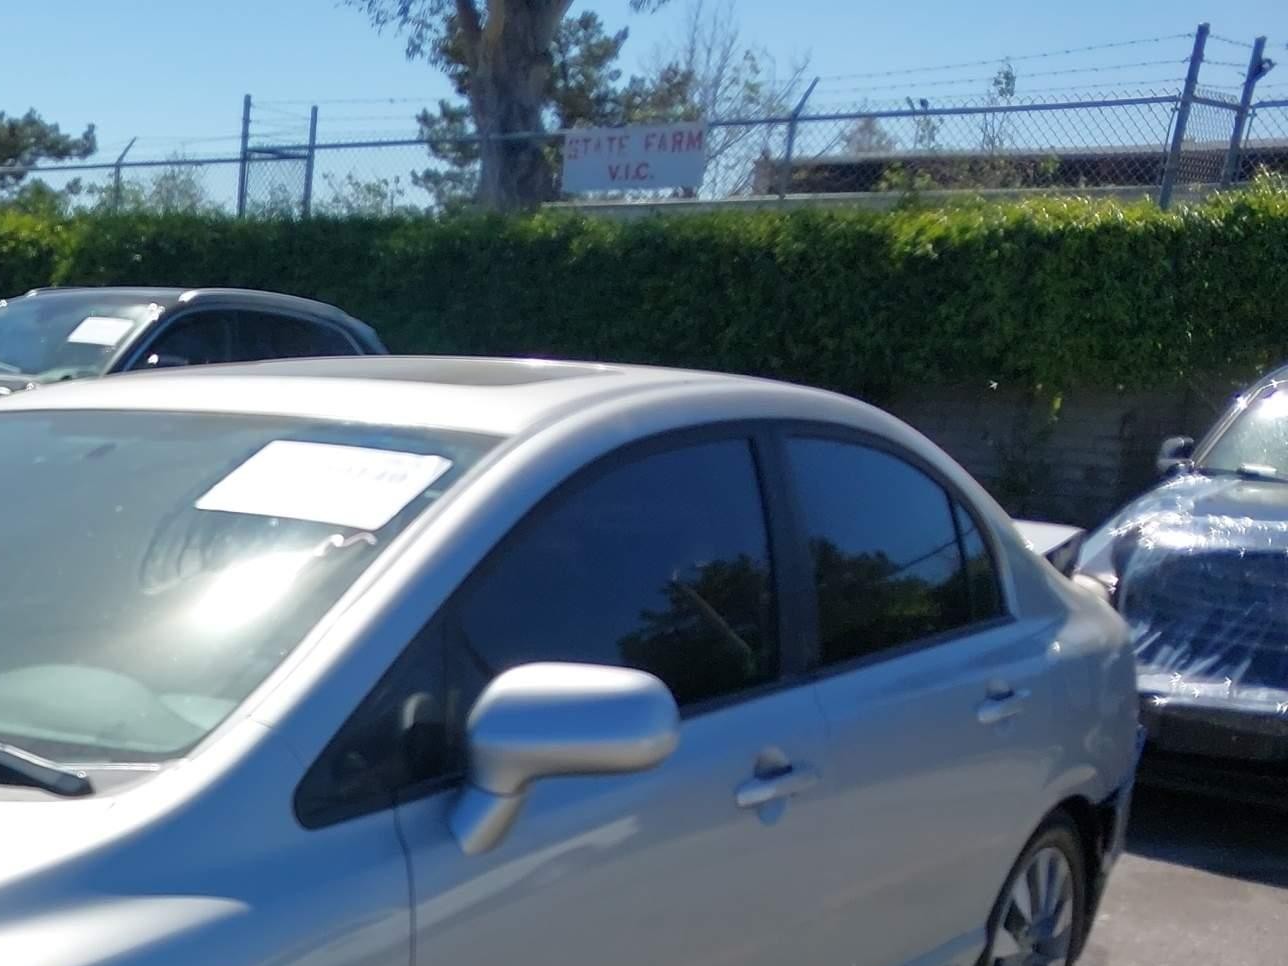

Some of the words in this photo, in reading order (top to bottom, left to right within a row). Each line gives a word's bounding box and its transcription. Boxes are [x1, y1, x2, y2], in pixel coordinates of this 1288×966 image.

[568, 135, 630, 159] STATE
[645, 130, 703, 153] FARM
[608, 162, 654, 181] V.I.C.
